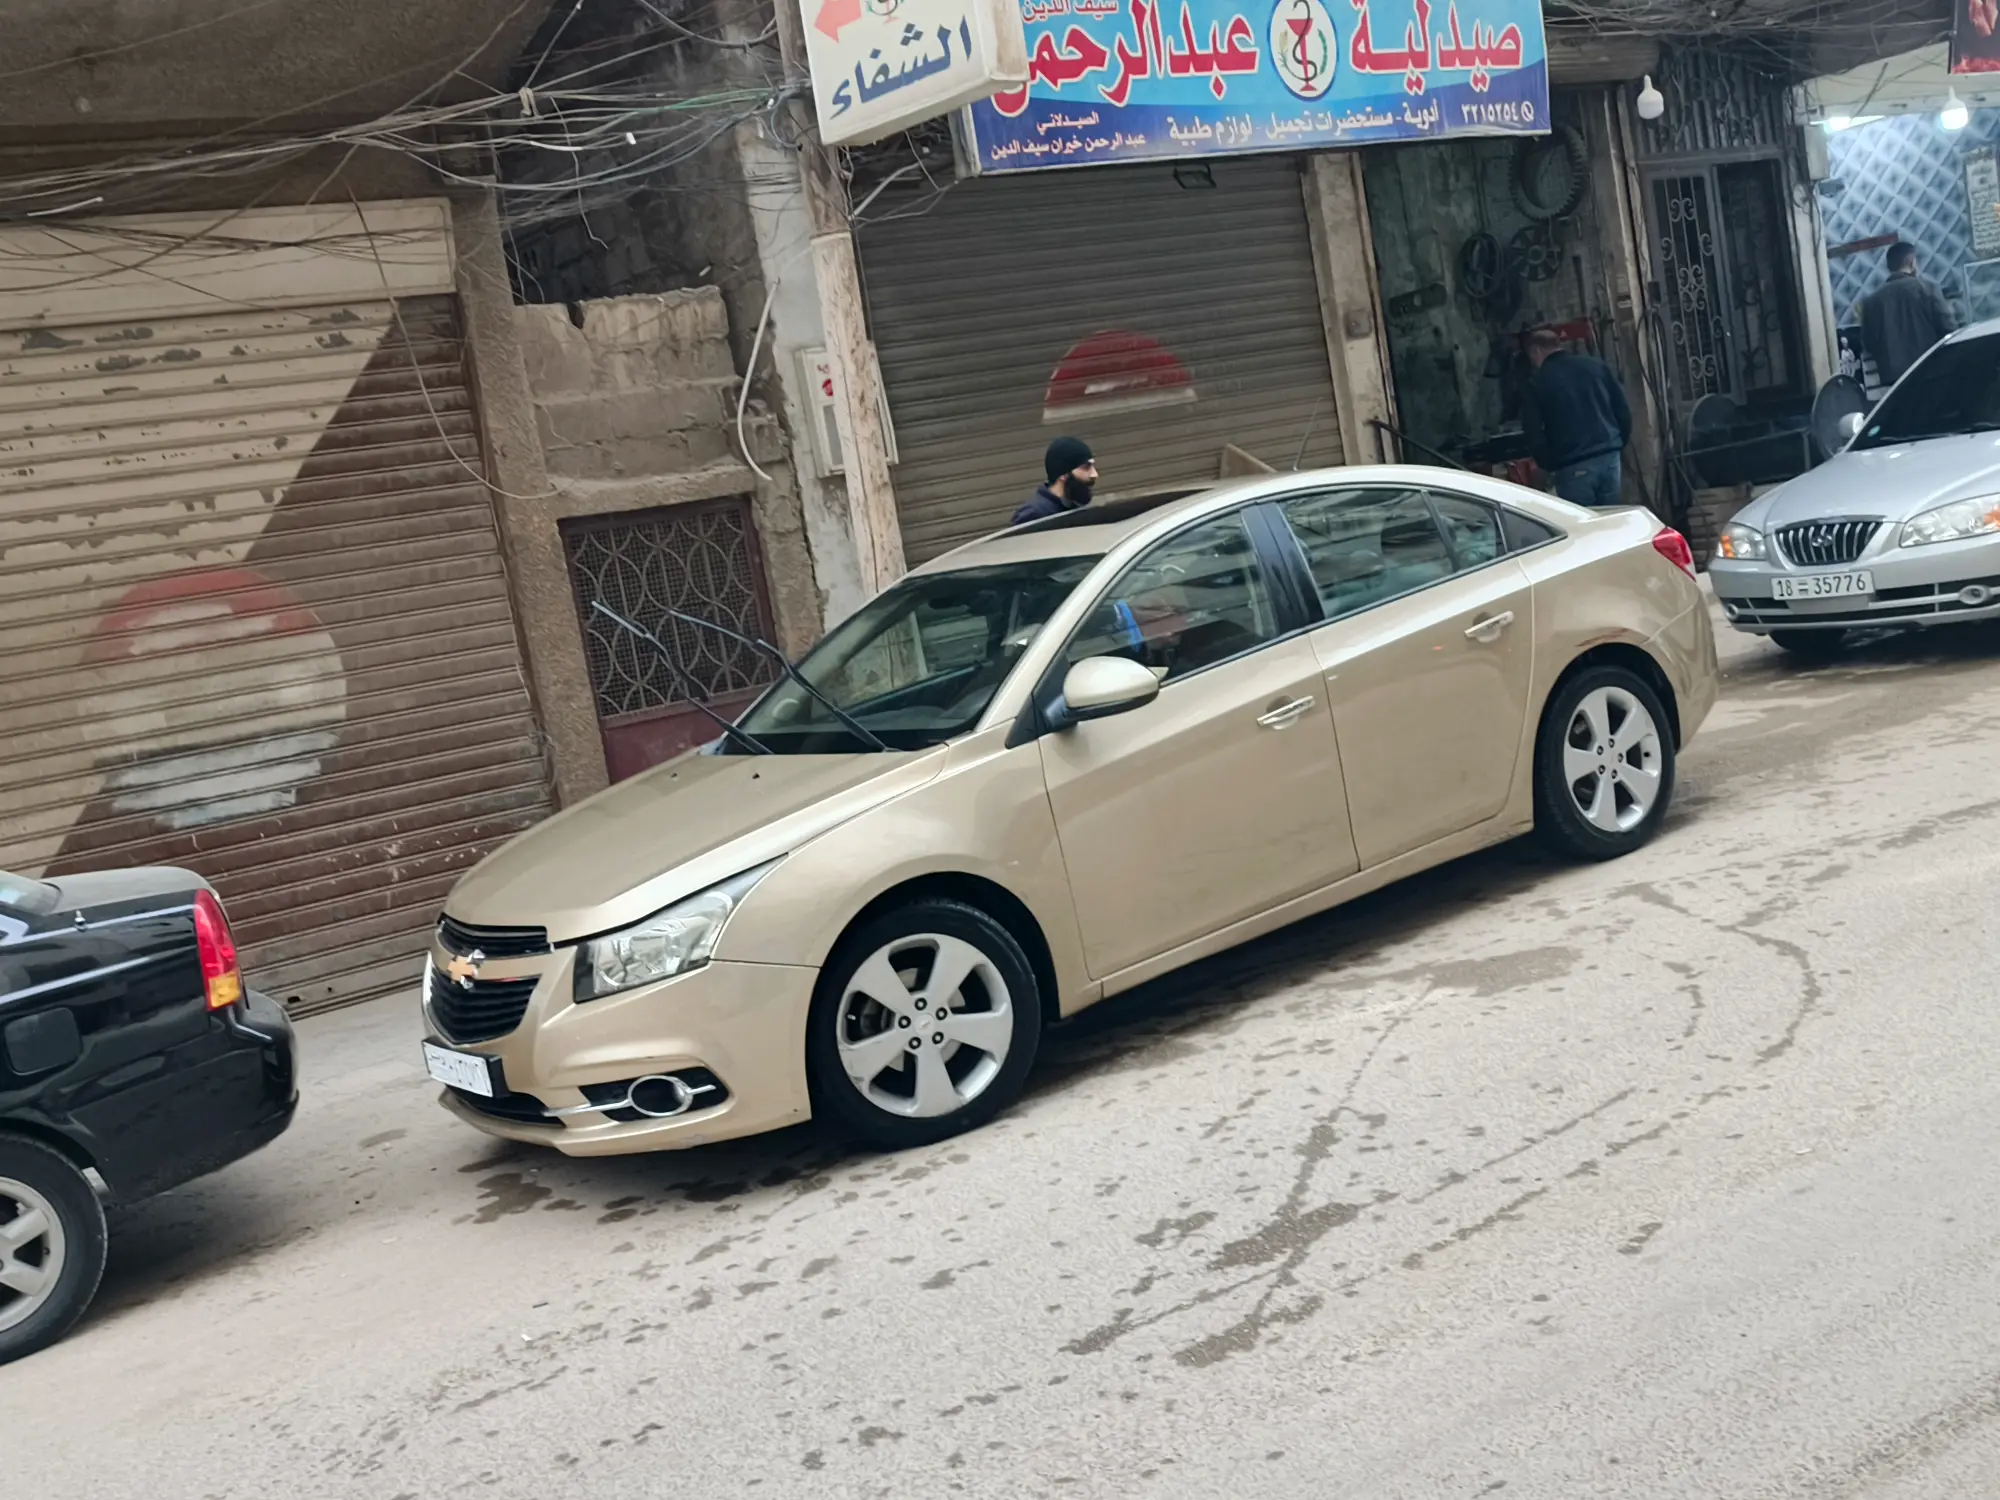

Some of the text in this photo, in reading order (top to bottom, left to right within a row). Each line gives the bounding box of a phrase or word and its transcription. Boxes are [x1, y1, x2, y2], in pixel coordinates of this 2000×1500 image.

[1350, 0, 1523, 95] صيدلية
[829, 13, 972, 120] الشفاء
[1036, 110, 1100, 136] الصيدلاني
[1166, 116, 1213, 146] طبية
[1215, 113, 1252, 145] لوازم
[1265, 110, 1313, 140] تجميل
[1315, 106, 1394, 137] مستحضرات
[990, 139, 1021, 160] الدين
[1021, 139, 1050, 157] سيف
[1084, 131, 1124, 152] الرحمن
[1124, 133, 1147, 146] عبد
[1811, 573, 1866, 595] 35776
